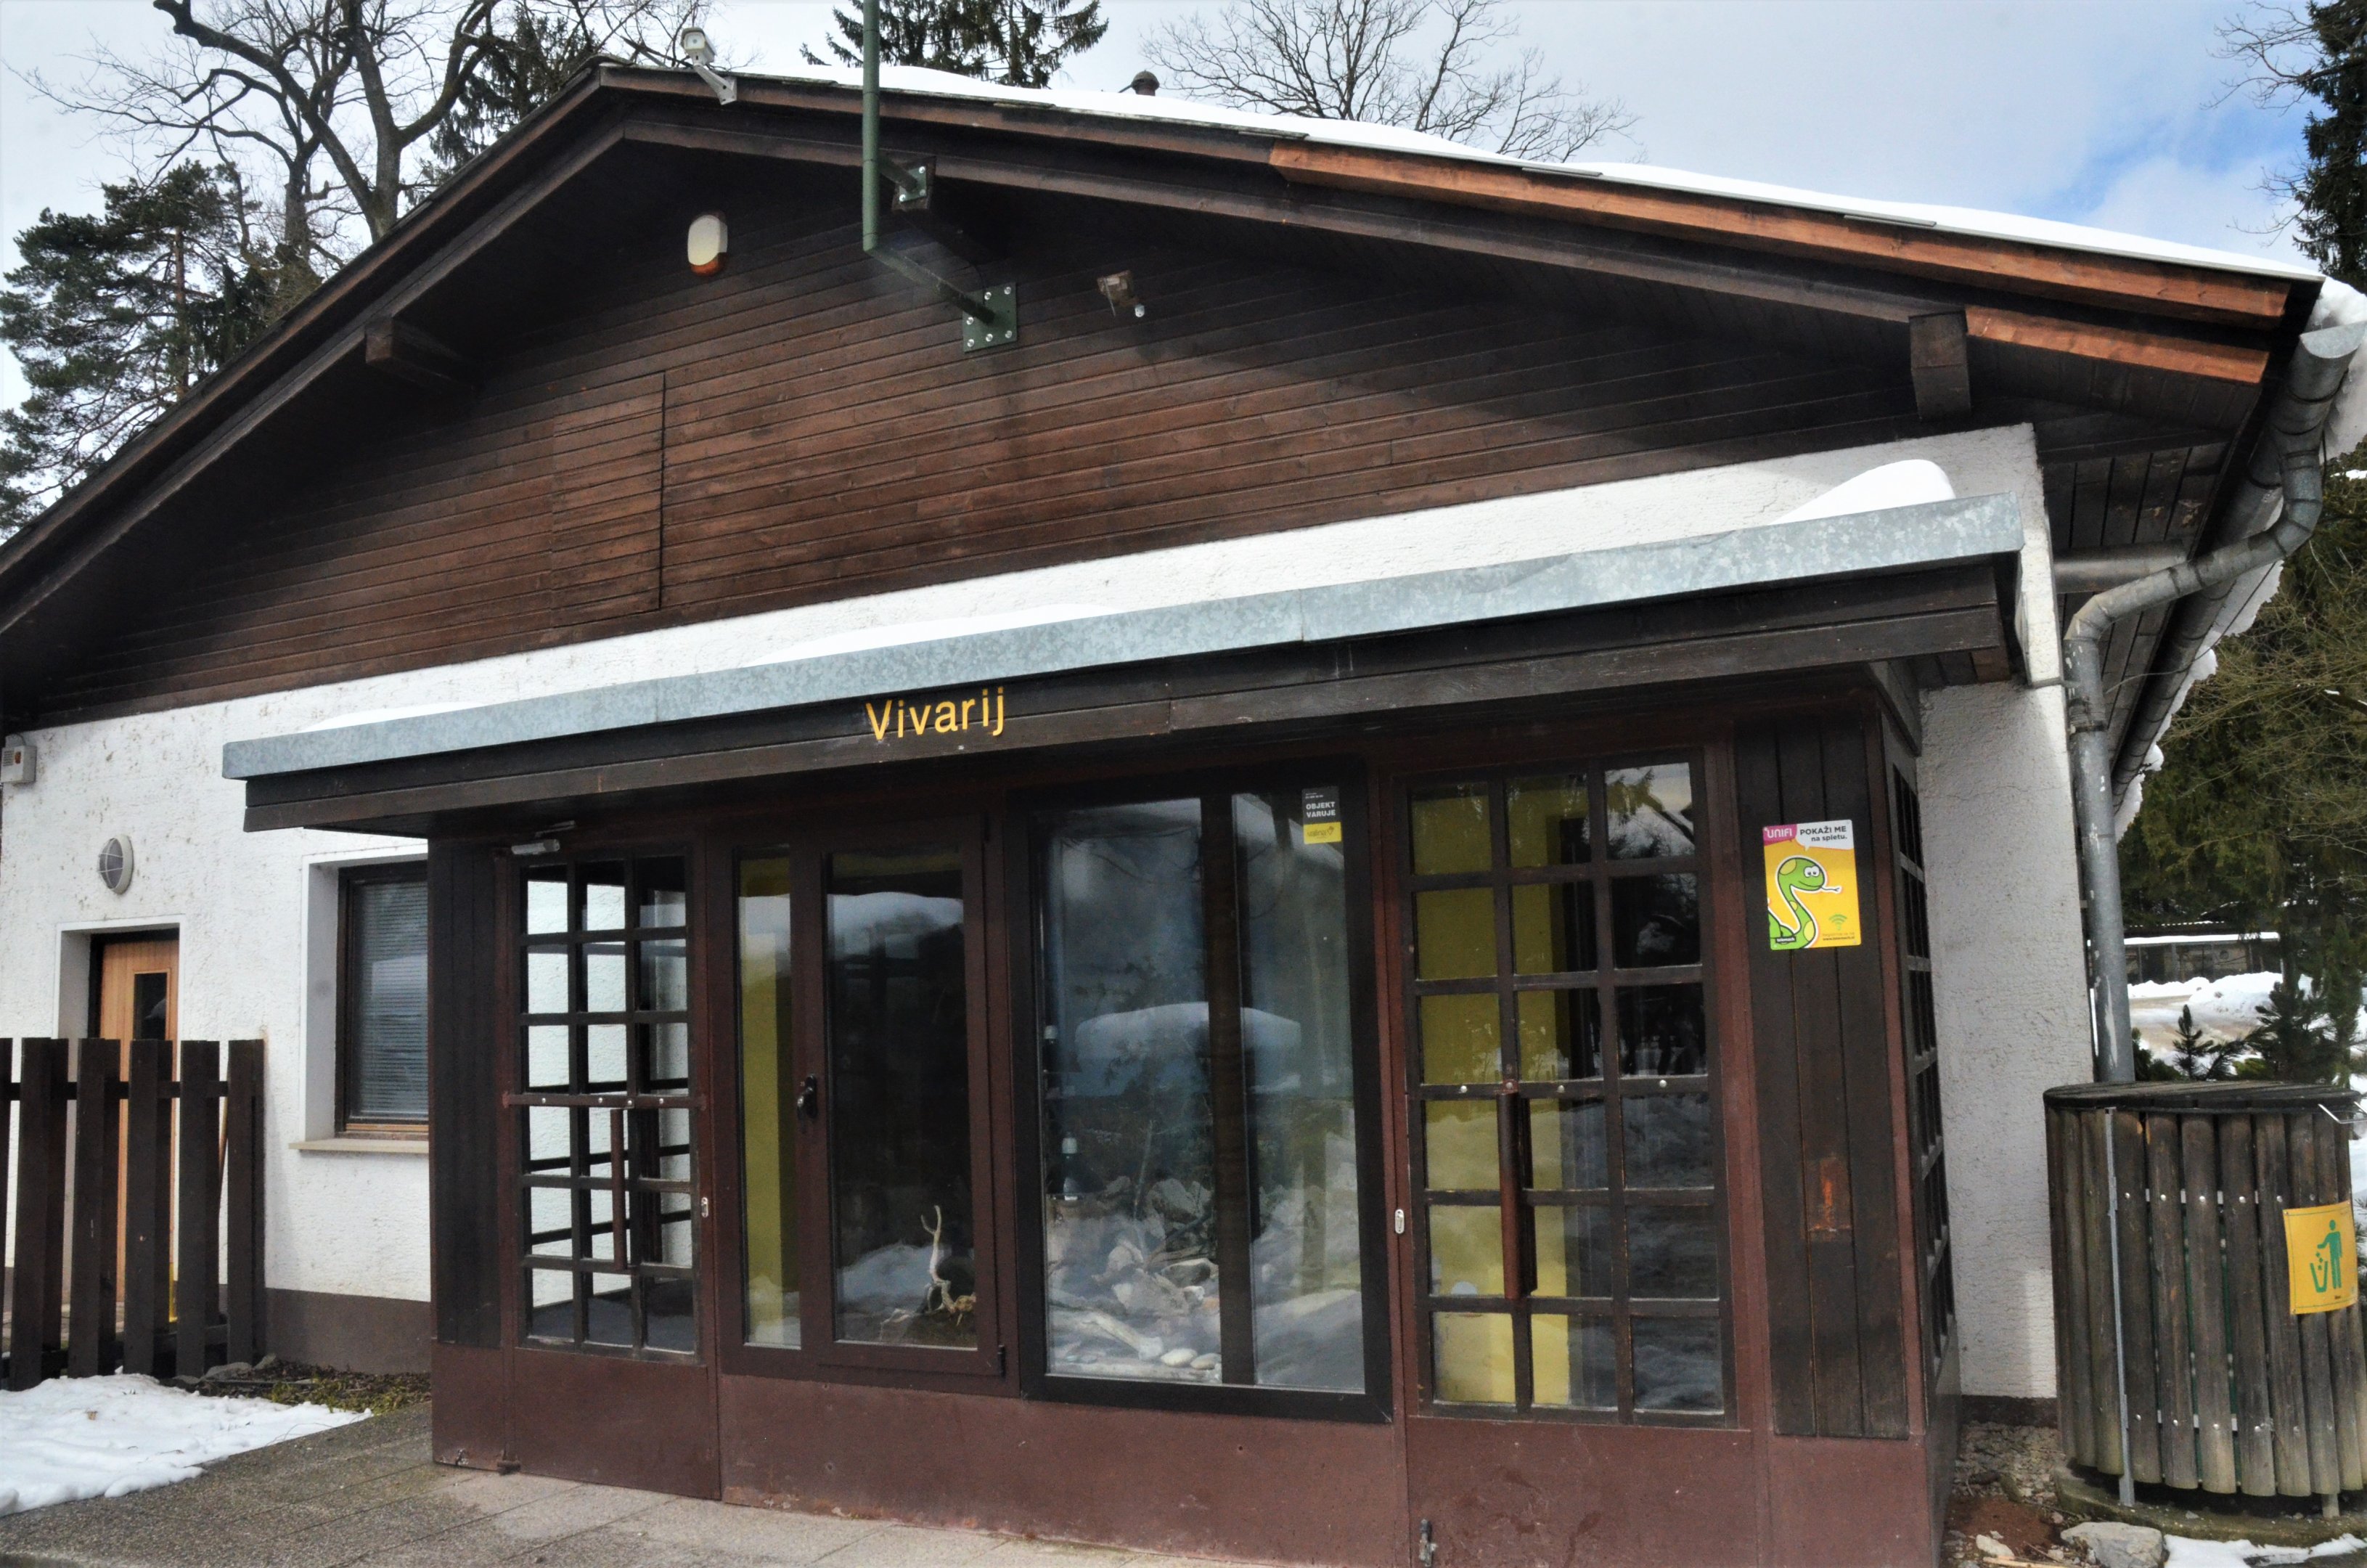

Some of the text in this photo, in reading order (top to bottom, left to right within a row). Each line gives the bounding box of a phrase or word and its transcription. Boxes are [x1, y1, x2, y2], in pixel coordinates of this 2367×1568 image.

[865, 686, 1005, 741] Vivarij
[1306, 801, 1336, 810] OBJEKT
[1306, 809, 1336, 818] VARUJE
[1799, 825, 1832, 836] POKAŽI
